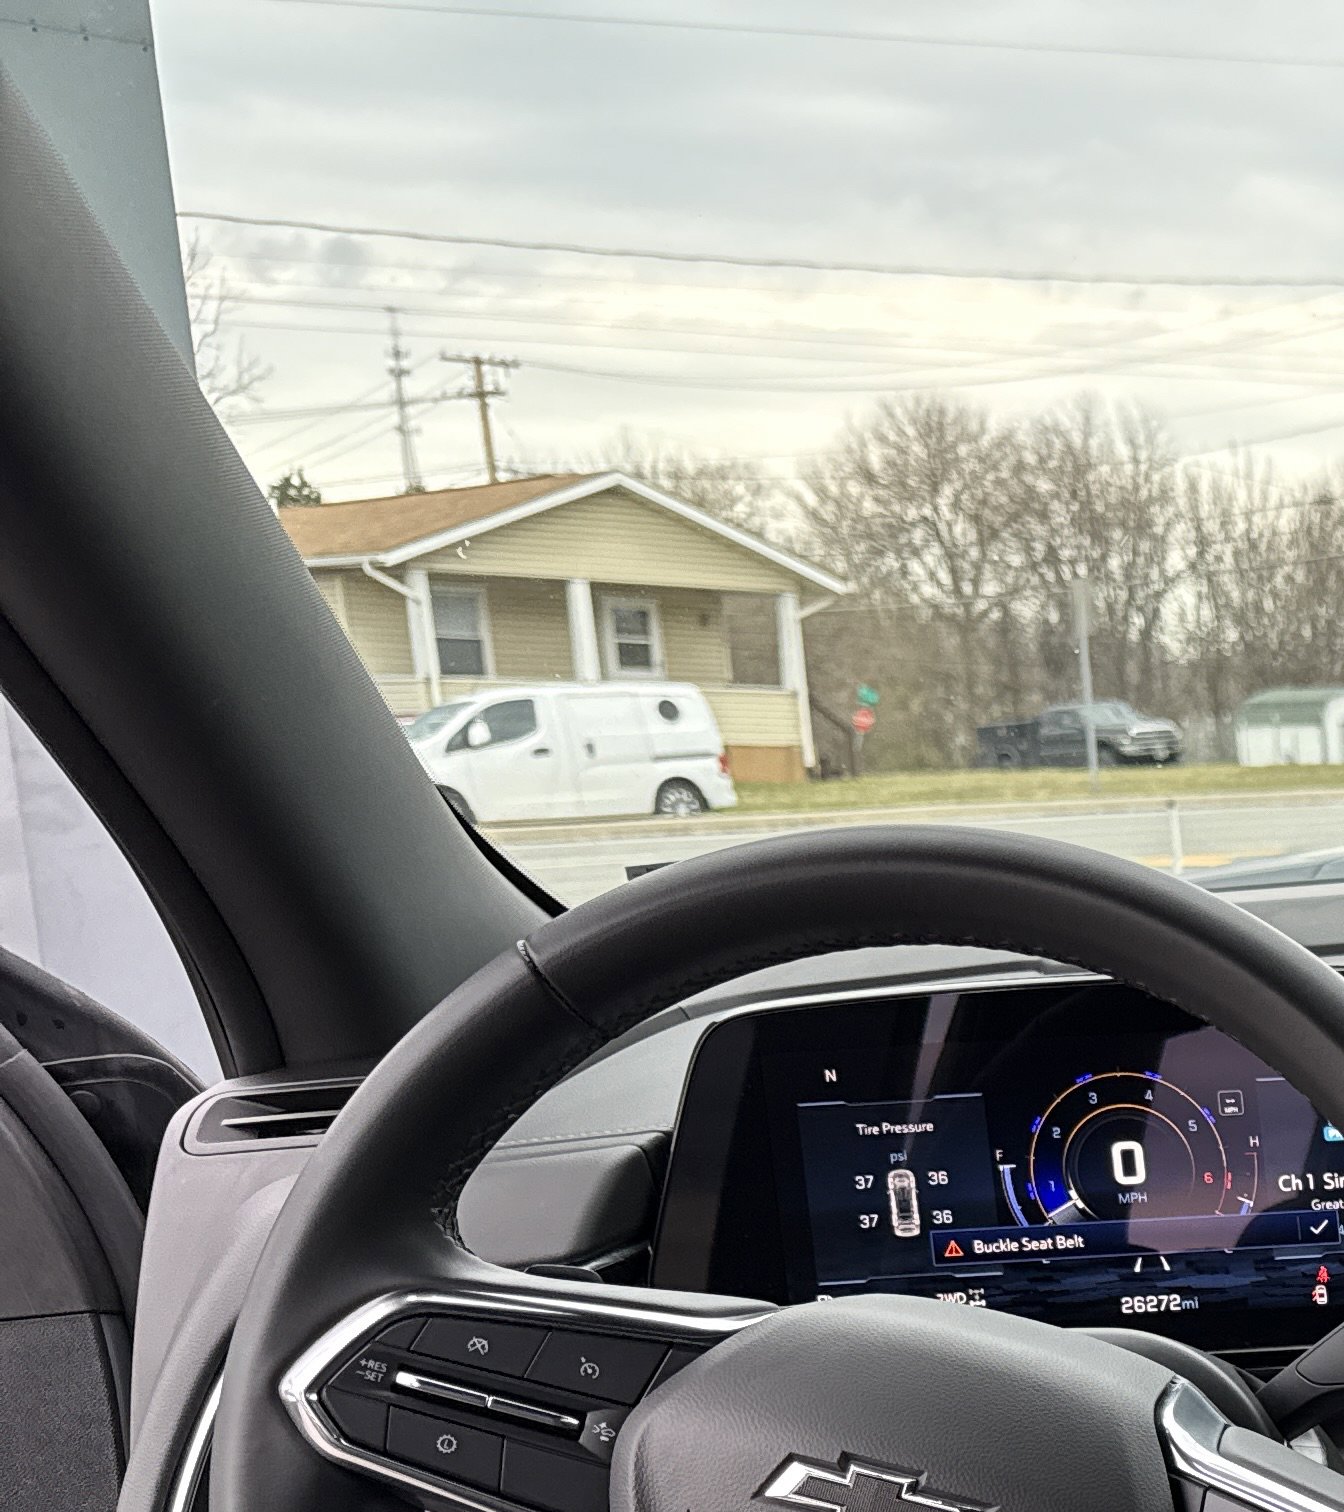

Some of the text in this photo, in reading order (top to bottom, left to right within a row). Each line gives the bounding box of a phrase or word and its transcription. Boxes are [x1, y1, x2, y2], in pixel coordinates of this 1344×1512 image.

[824, 1068, 837, 1083] N
[1088, 1092, 1098, 1105] 3
[1144, 1089, 1154, 1101] 4
[855, 1121, 935, 1136] Tire Pressure
[1052, 1126, 1062, 1139] 2
[1188, 1120, 1198, 1132] 5
[1249, 1135, 1260, 1148] H
[889, 1150, 908, 1165] psi
[995, 1149, 1004, 1162] F
[1111, 1141, 1146, 1185] 0
[855, 1171, 949, 1190] 37 36
[1203, 1172, 1214, 1184] 6
[1277, 1173, 1303, 1192] Ch
[1306, 1173, 1314, 1190] 1
[1048, 1179, 1056, 1192] 1
[1117, 1192, 1148, 1204] MPH
[859, 1210, 953, 1229] 37 36
[973, 1234, 1085, 1254] Buckle Seat Belt
